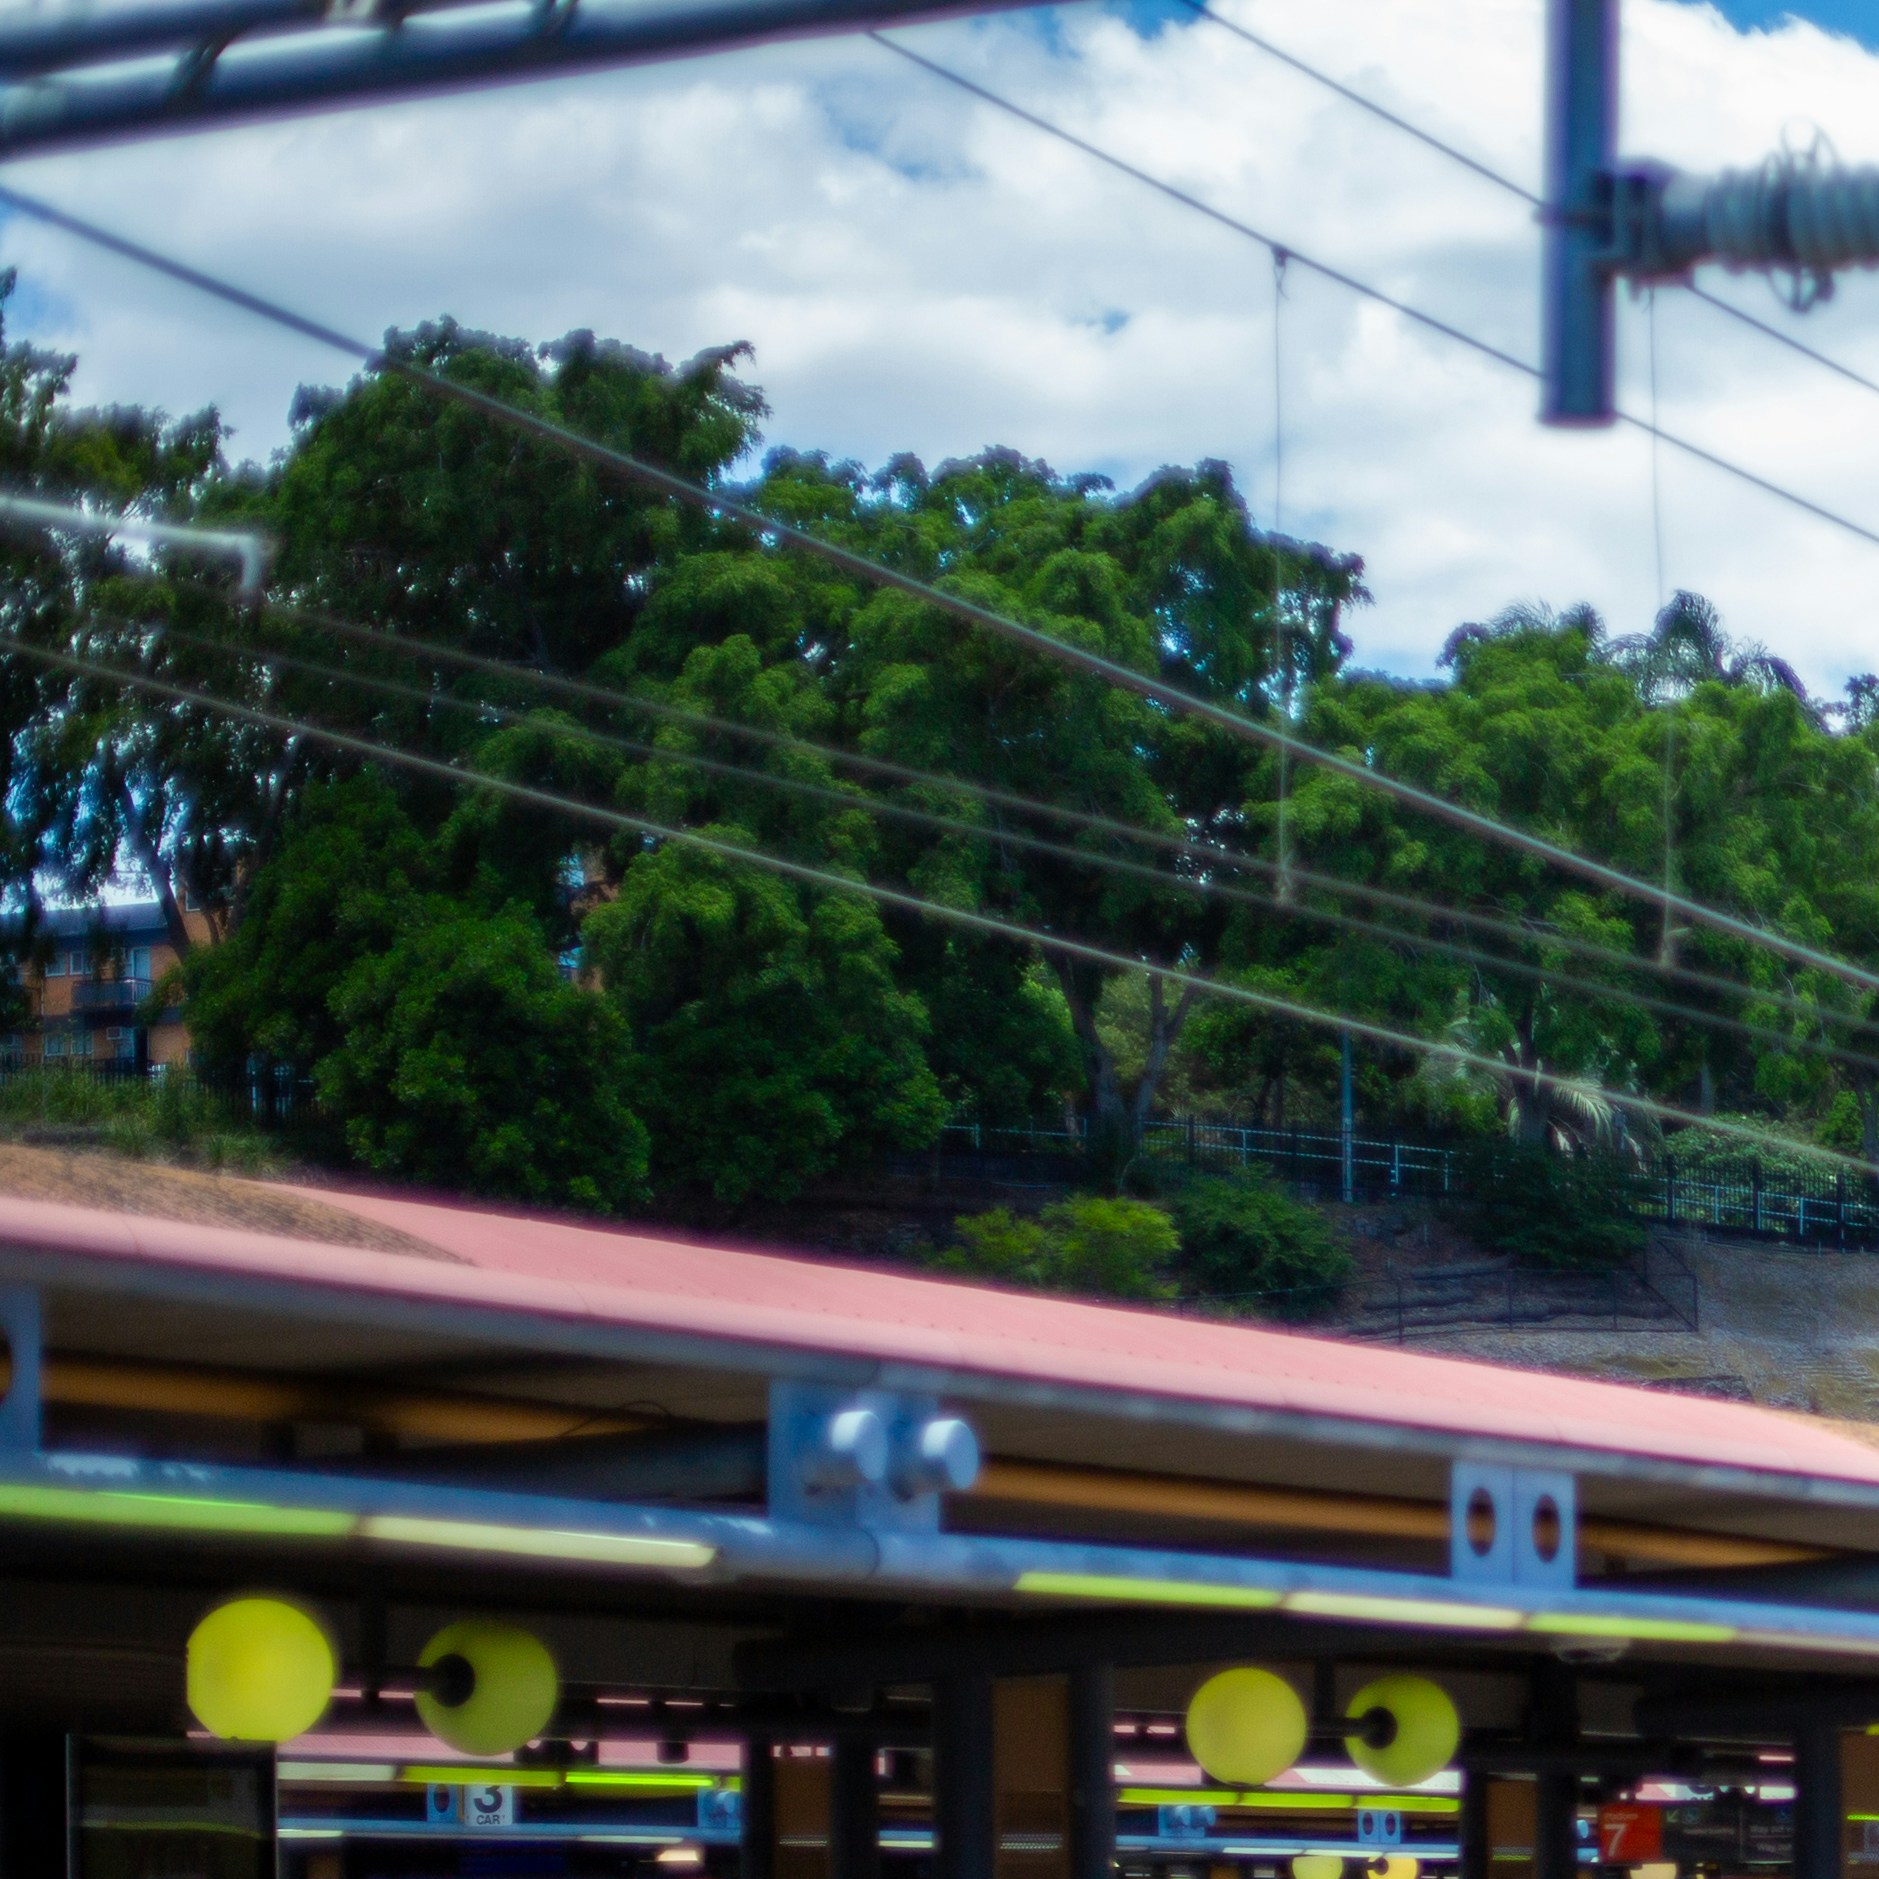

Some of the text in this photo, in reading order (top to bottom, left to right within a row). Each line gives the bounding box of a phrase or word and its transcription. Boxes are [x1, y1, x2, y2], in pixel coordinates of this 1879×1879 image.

[474, 1786, 503, 1814] 3
[476, 1814, 502, 1825] CAR
[1604, 1823, 1628, 1858] 7
